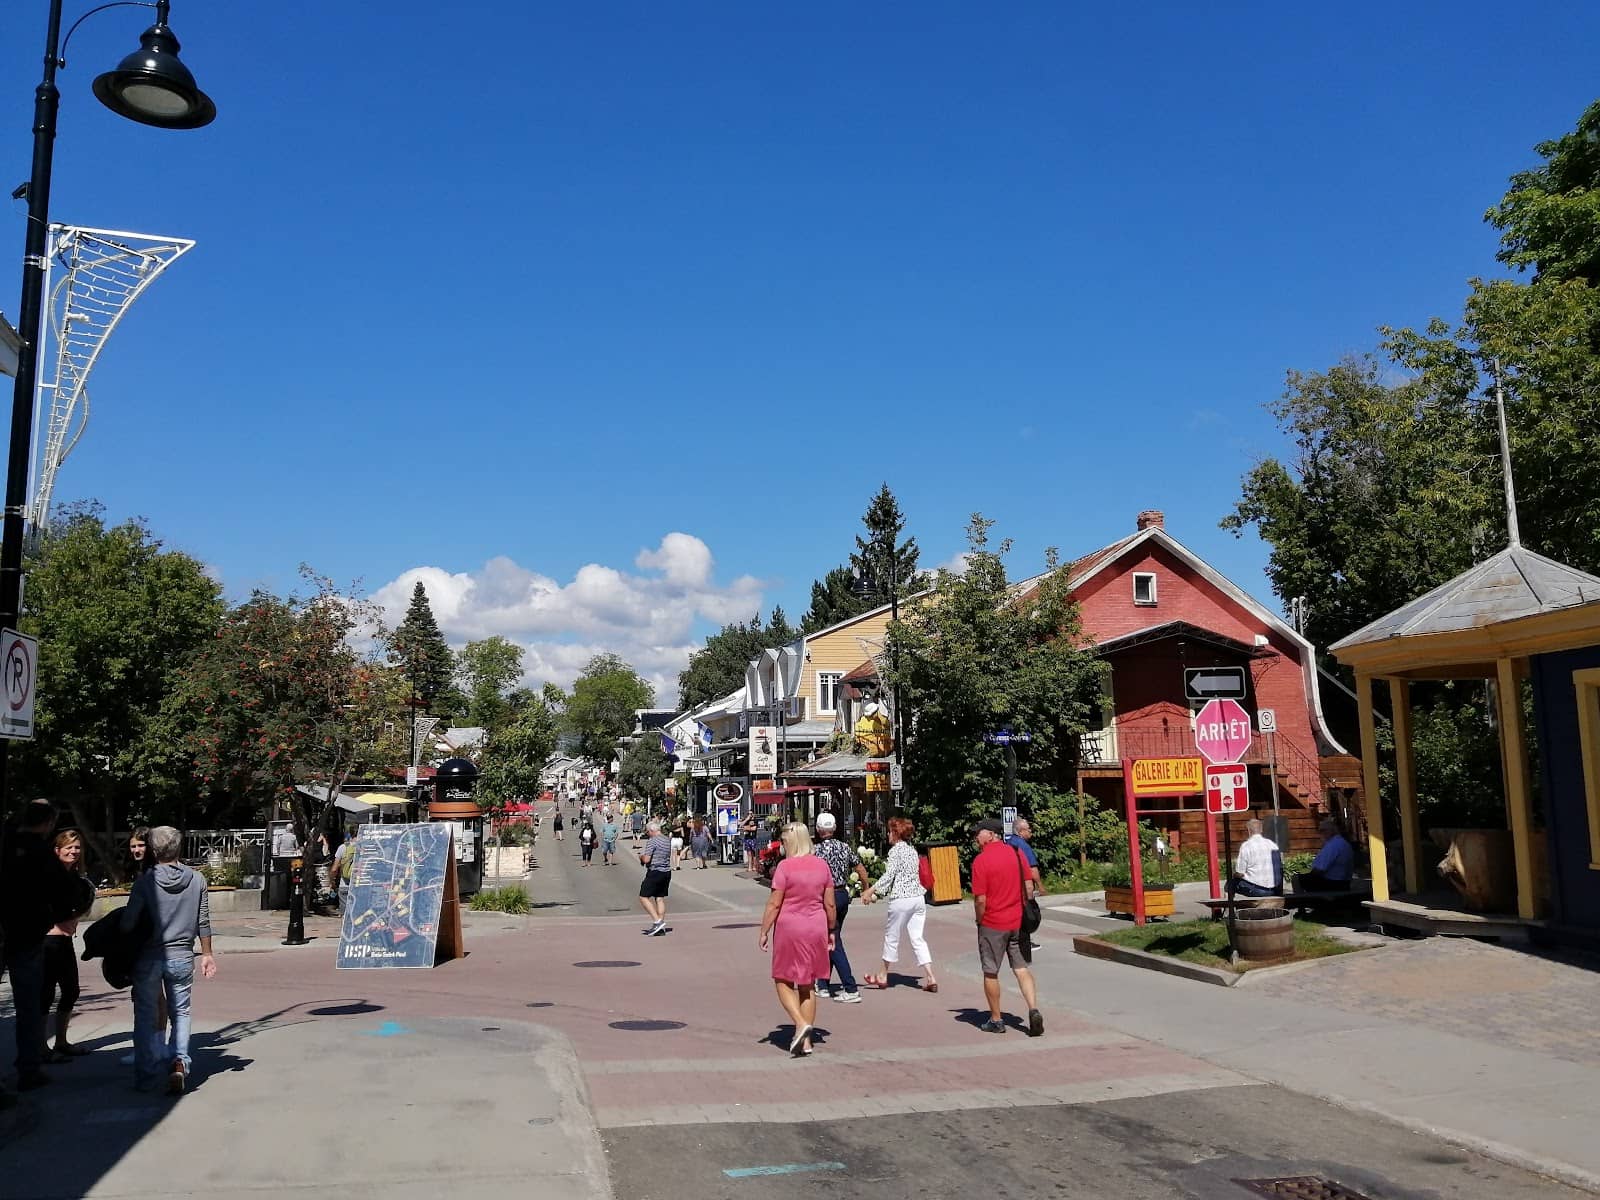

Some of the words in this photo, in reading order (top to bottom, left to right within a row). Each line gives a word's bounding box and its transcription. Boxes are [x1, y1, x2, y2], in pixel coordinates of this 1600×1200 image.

[1199, 718, 1247, 742] ARRÊT
[1135, 762, 1171, 781] GALERIE
[1174, 761, 1198, 779] d'ART
[344, 944, 371, 958] BSP
